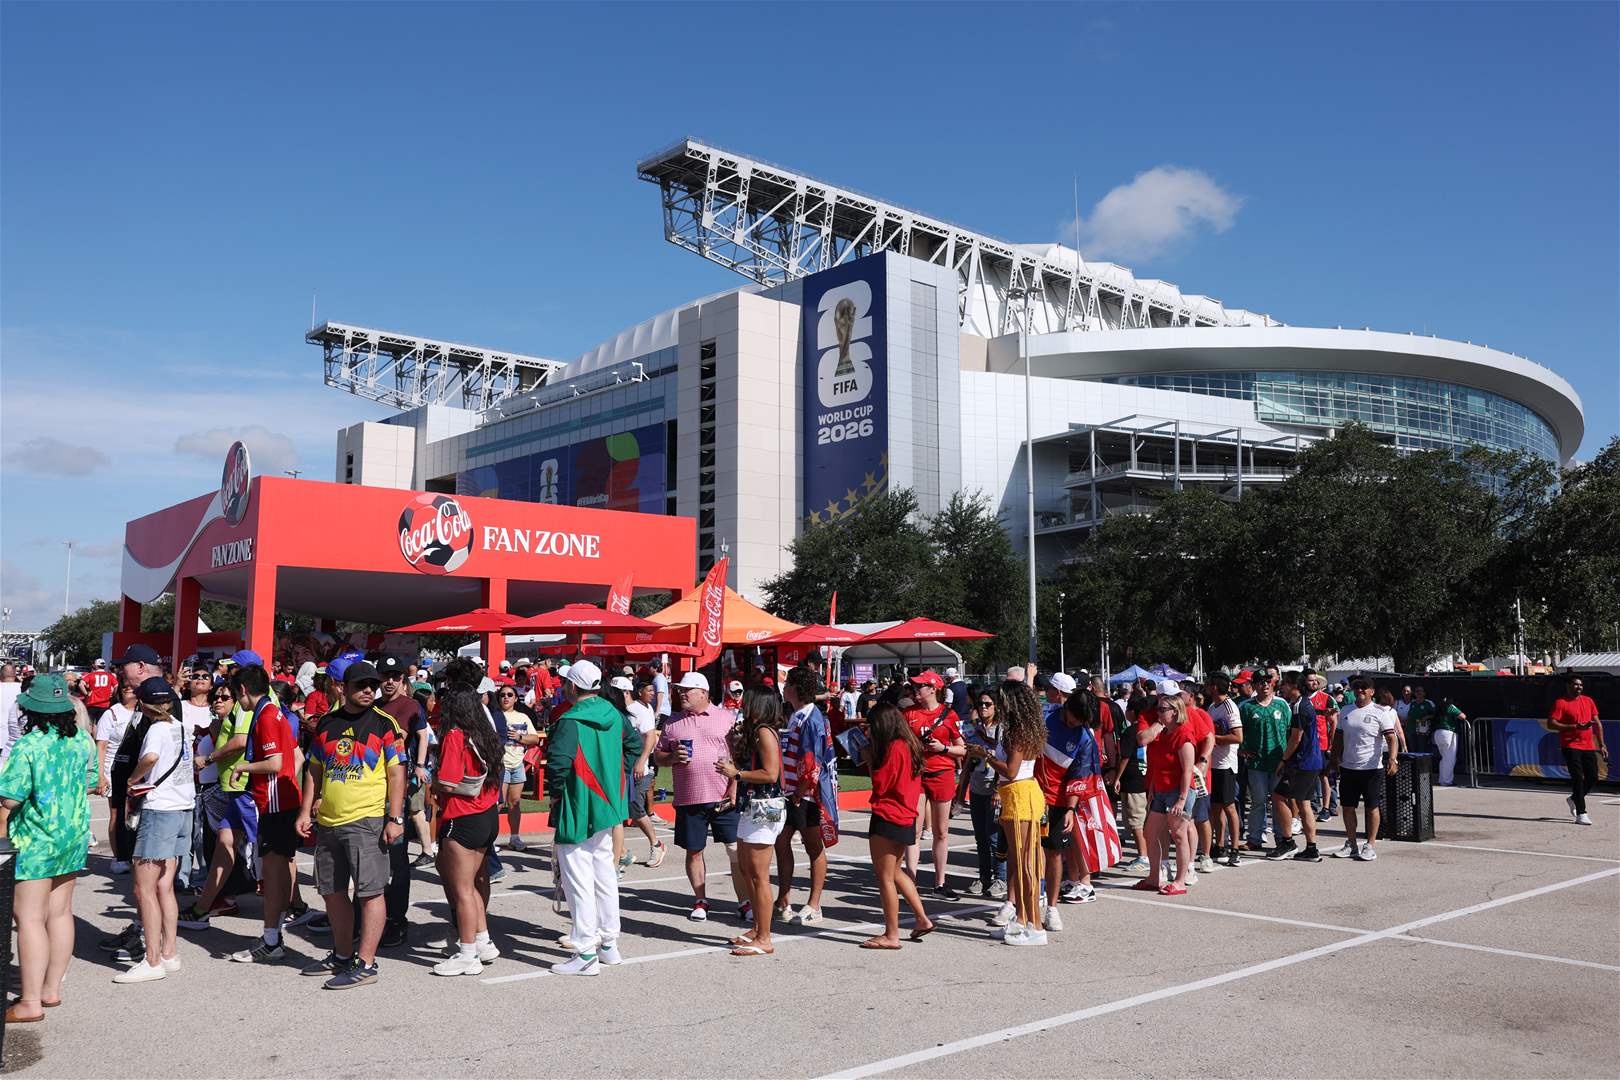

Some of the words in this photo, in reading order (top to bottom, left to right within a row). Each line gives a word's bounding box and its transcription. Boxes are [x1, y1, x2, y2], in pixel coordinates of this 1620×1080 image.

[833, 379, 858, 395] FIFA
[818, 409, 851, 425] WORLD
[854, 405, 874, 418] CUP
[818, 418, 874, 445] 2026
[400, 502, 472, 562] Coca-Cola
[483, 526, 530, 552] FAN
[535, 531, 600, 558] ZONE
[211, 545, 228, 568] FAN
[228, 538, 252, 564] ZONE
[703, 583, 723, 646] Coca-Cola
[95, 674, 108, 687] 10
